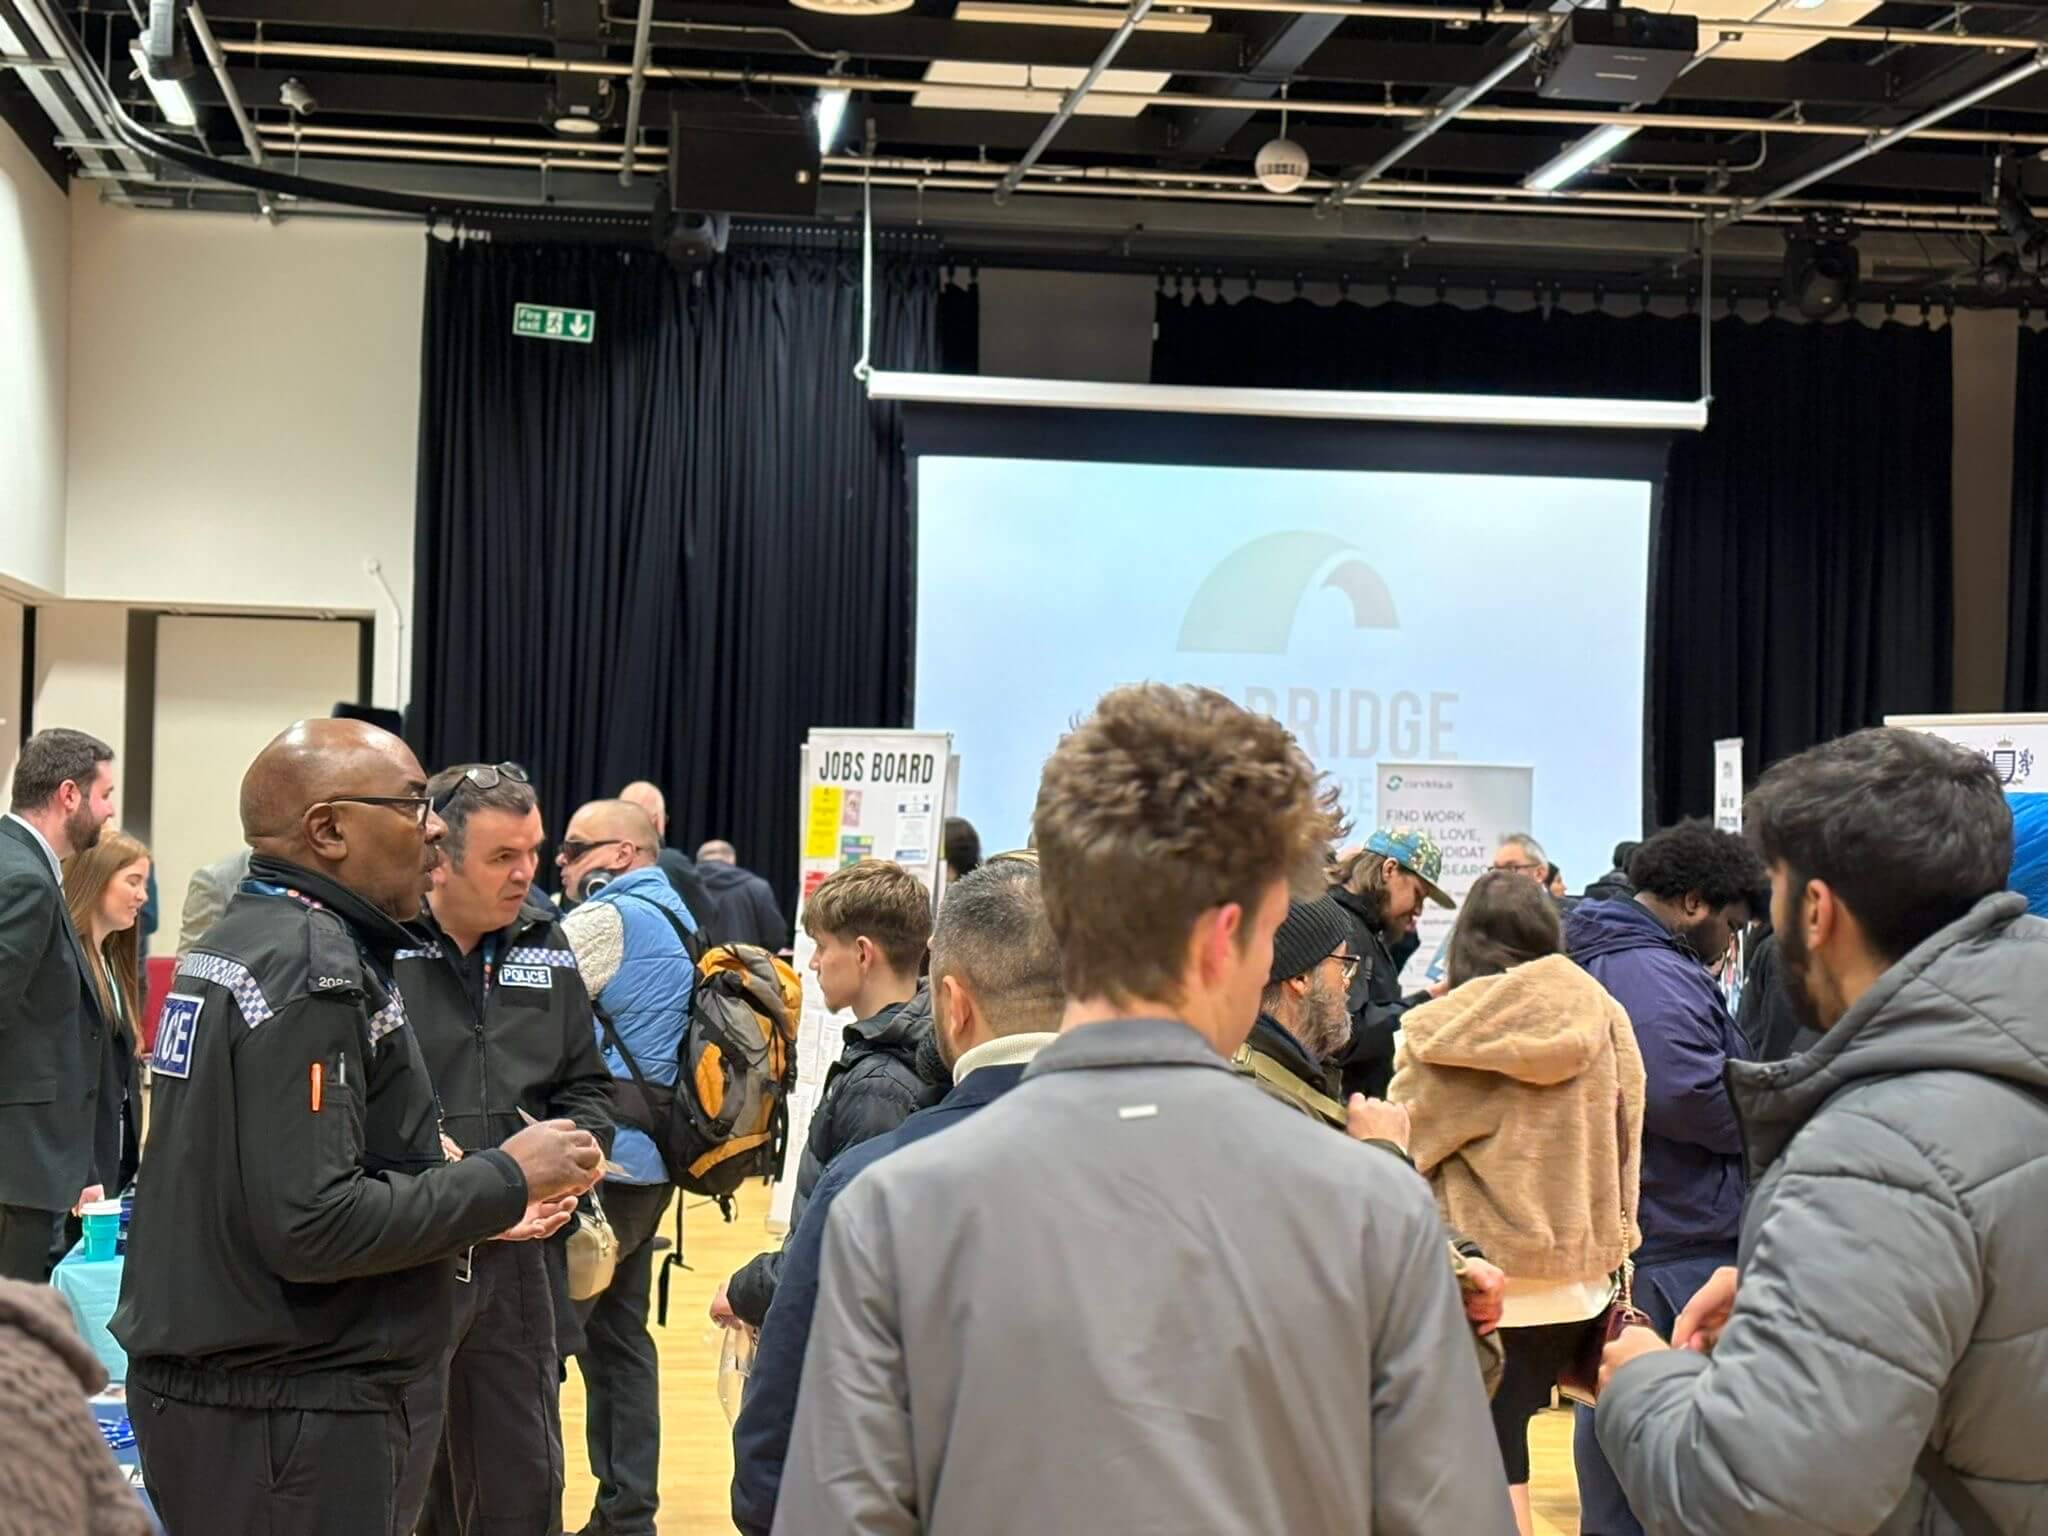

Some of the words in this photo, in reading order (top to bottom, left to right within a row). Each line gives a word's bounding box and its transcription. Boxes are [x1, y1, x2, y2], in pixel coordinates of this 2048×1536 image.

[819, 751, 865, 782] JOBS
[871, 752, 934, 783] BOARD
[1385, 809, 1419, 823] FIND
[1423, 810, 1466, 823] WORK
[1440, 828, 1482, 843] LOVE,
[503, 967, 548, 983] POLICE
